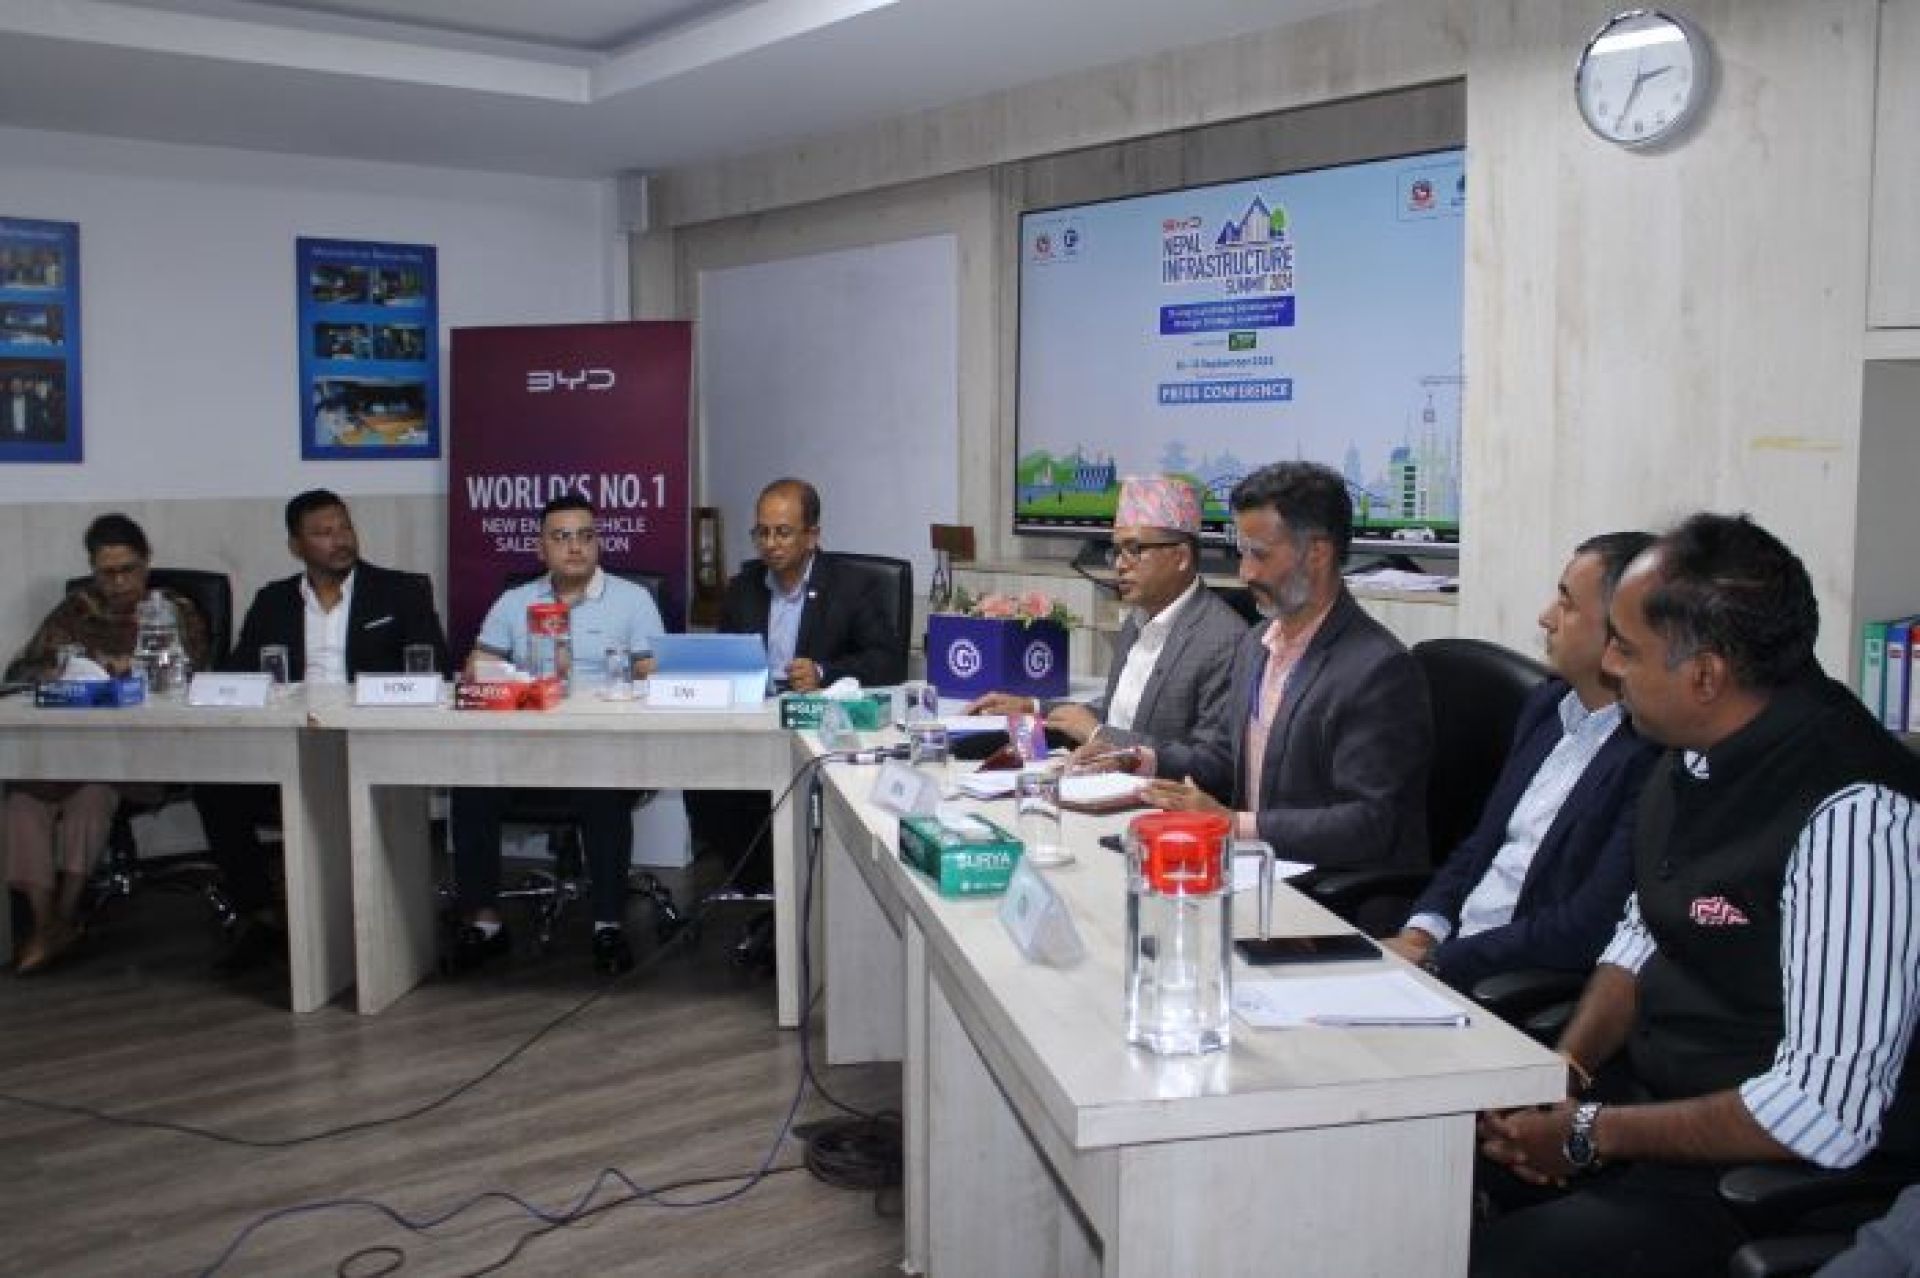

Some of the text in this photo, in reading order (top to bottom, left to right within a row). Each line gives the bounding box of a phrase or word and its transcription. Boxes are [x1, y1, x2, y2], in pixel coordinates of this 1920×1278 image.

[1163, 233, 1202, 257] NEPAL
[1163, 244, 1293, 283] INFRASTRUCTURE
[526, 369, 616, 392] BYD
[1203, 383, 1290, 399] CONFERENCE
[600, 473, 648, 509] NO.
[652, 473, 666, 508] 1
[482, 517, 516, 533] NEW
[595, 517, 647, 533] EHICLE
[956, 851, 1012, 870] SURYA
